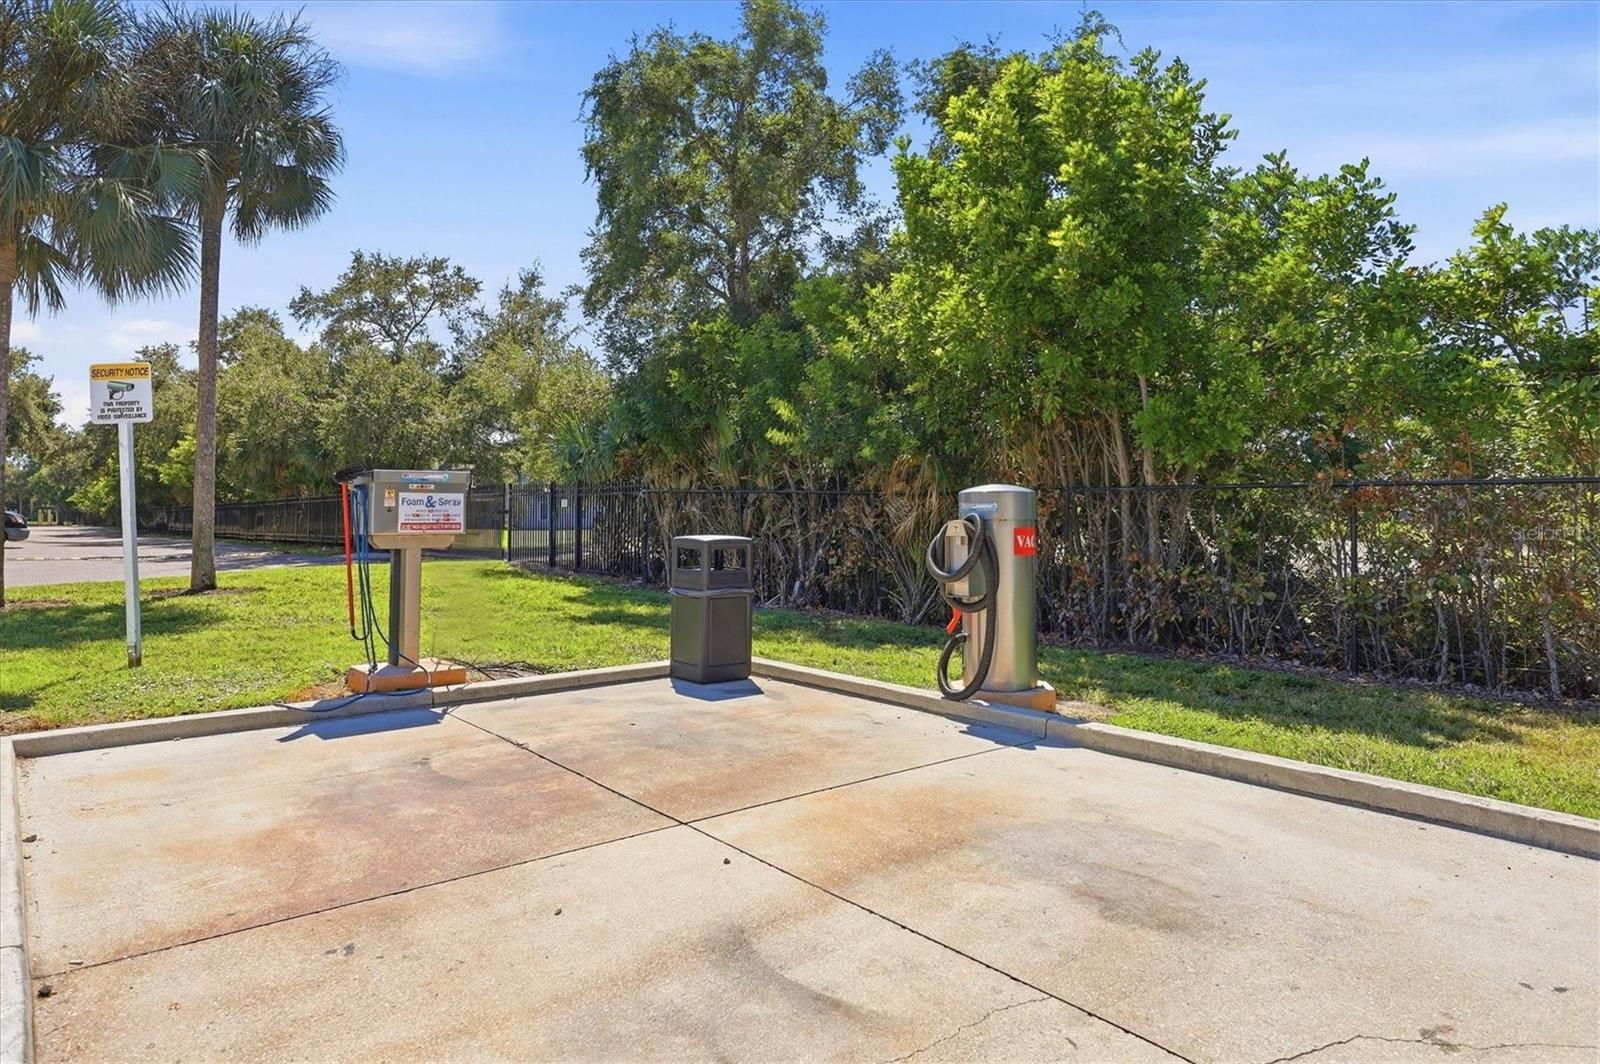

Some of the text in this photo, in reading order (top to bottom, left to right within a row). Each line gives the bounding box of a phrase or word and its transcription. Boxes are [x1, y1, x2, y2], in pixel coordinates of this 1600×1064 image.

[91, 367, 149, 378] SECURITY NOTICE
[401, 497, 425, 506] Foam
[425, 495, 438, 508] &
[438, 497, 462, 507] Spray
